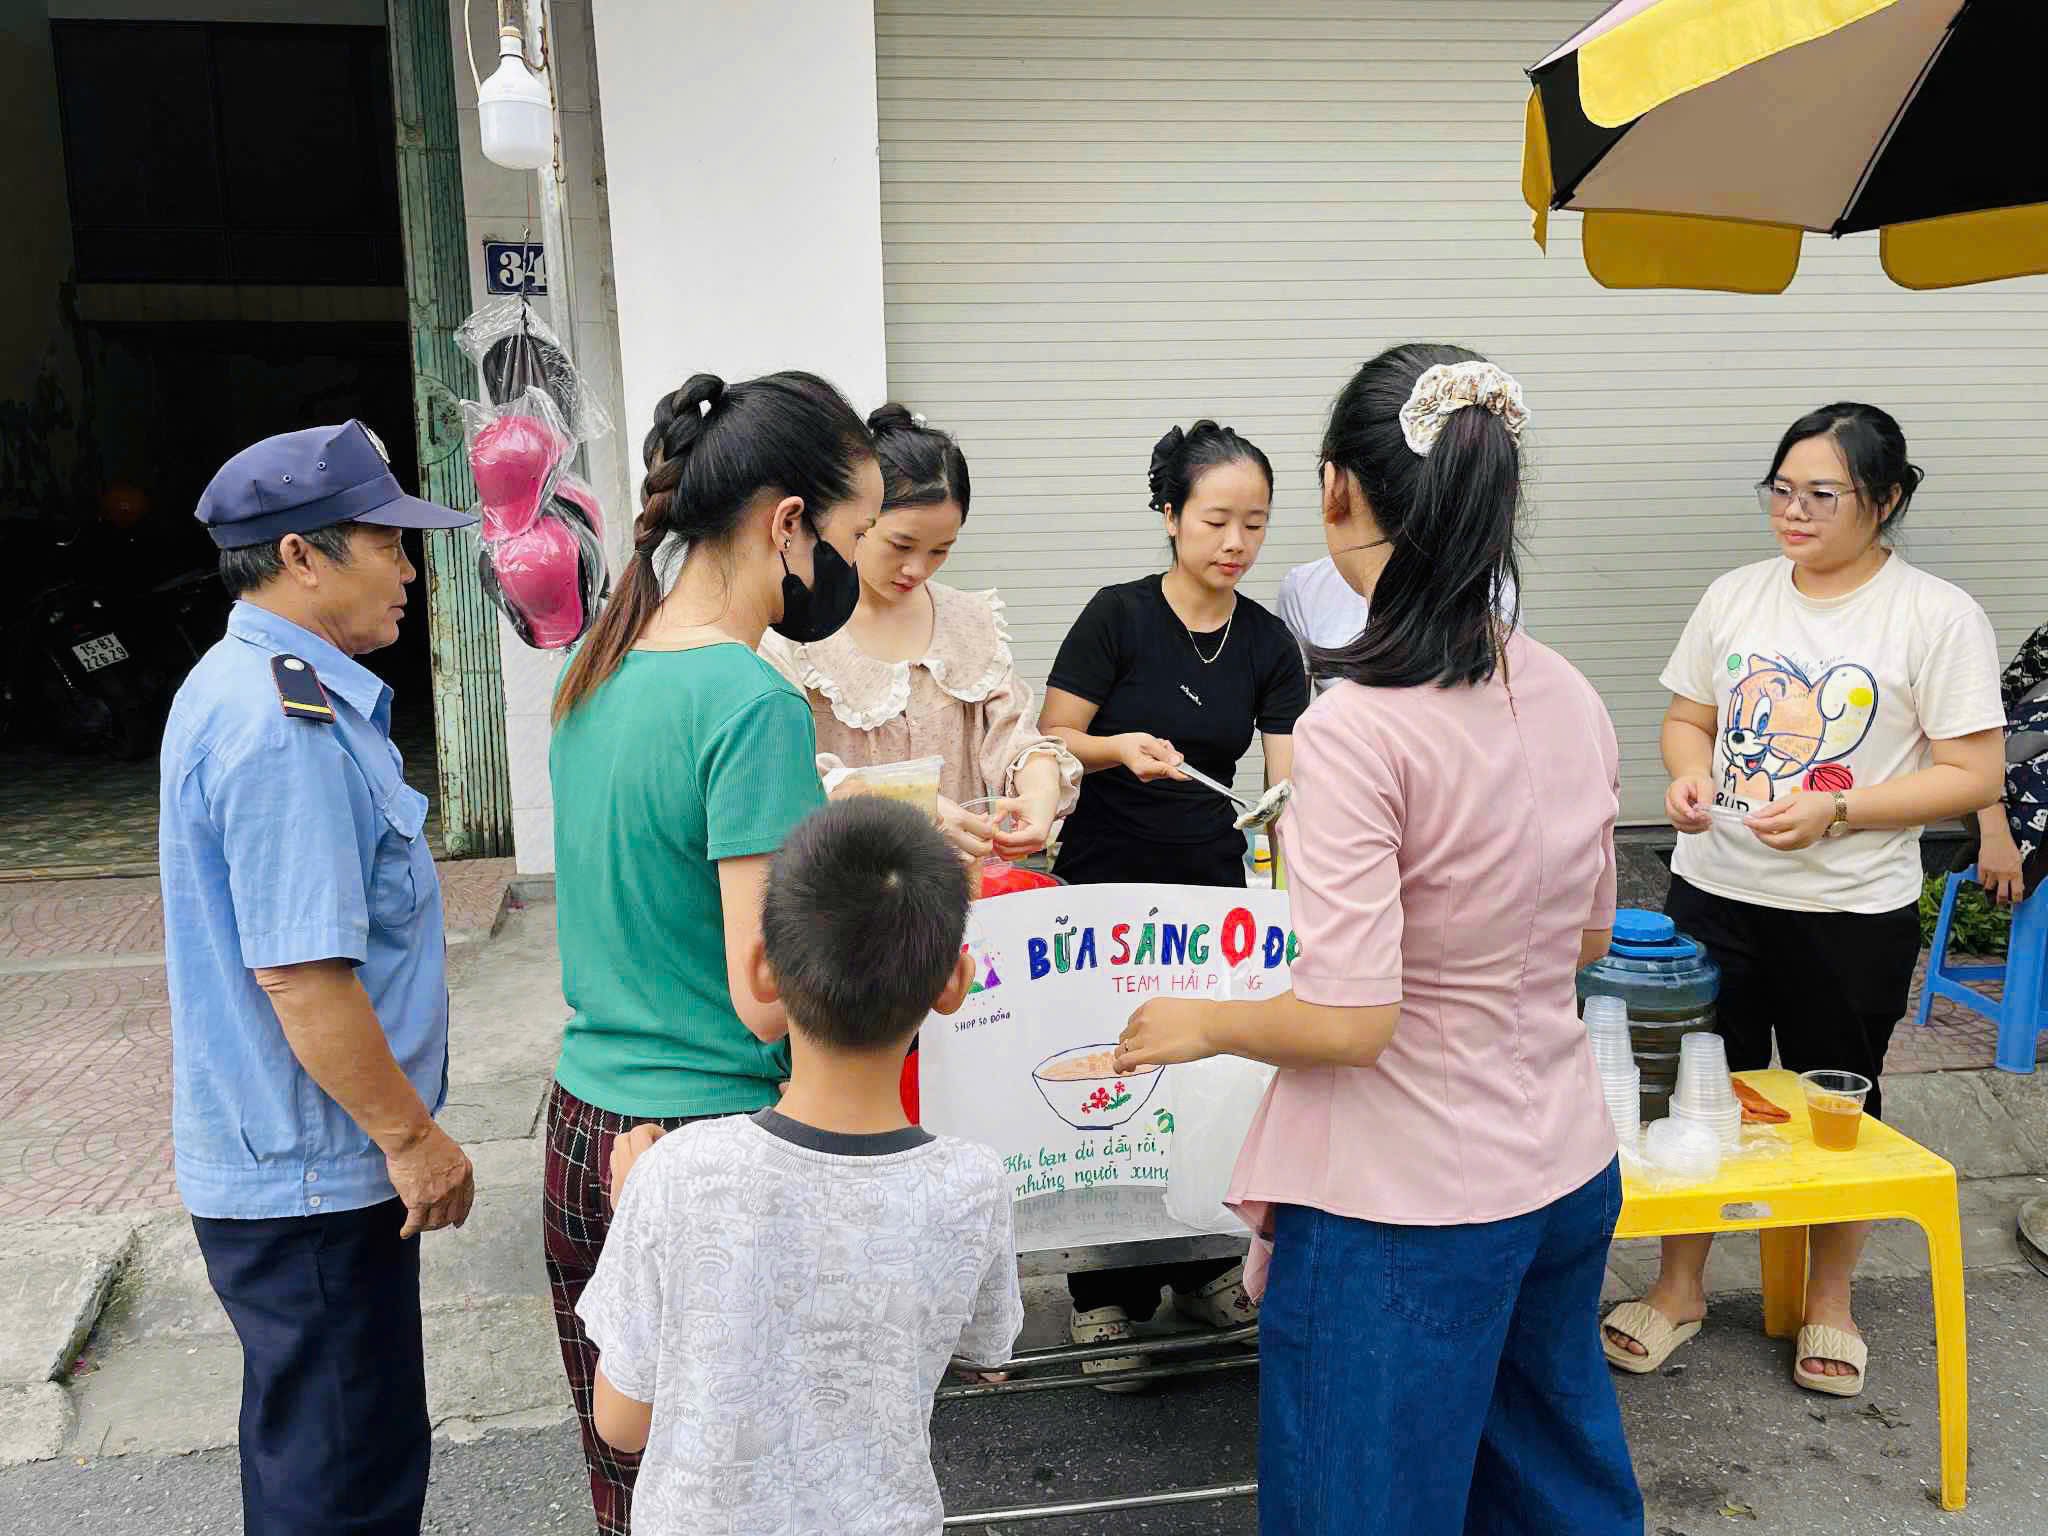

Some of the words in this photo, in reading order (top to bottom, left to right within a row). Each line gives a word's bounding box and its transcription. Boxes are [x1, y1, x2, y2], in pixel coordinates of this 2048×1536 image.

[1027, 915, 1098, 981] BỮA
[1110, 906, 1211, 967] SÁNG
[1112, 975, 1160, 993] TEAM
[1003, 1153, 1032, 1174] Khi
[1039, 1147, 1068, 1171] bạn
